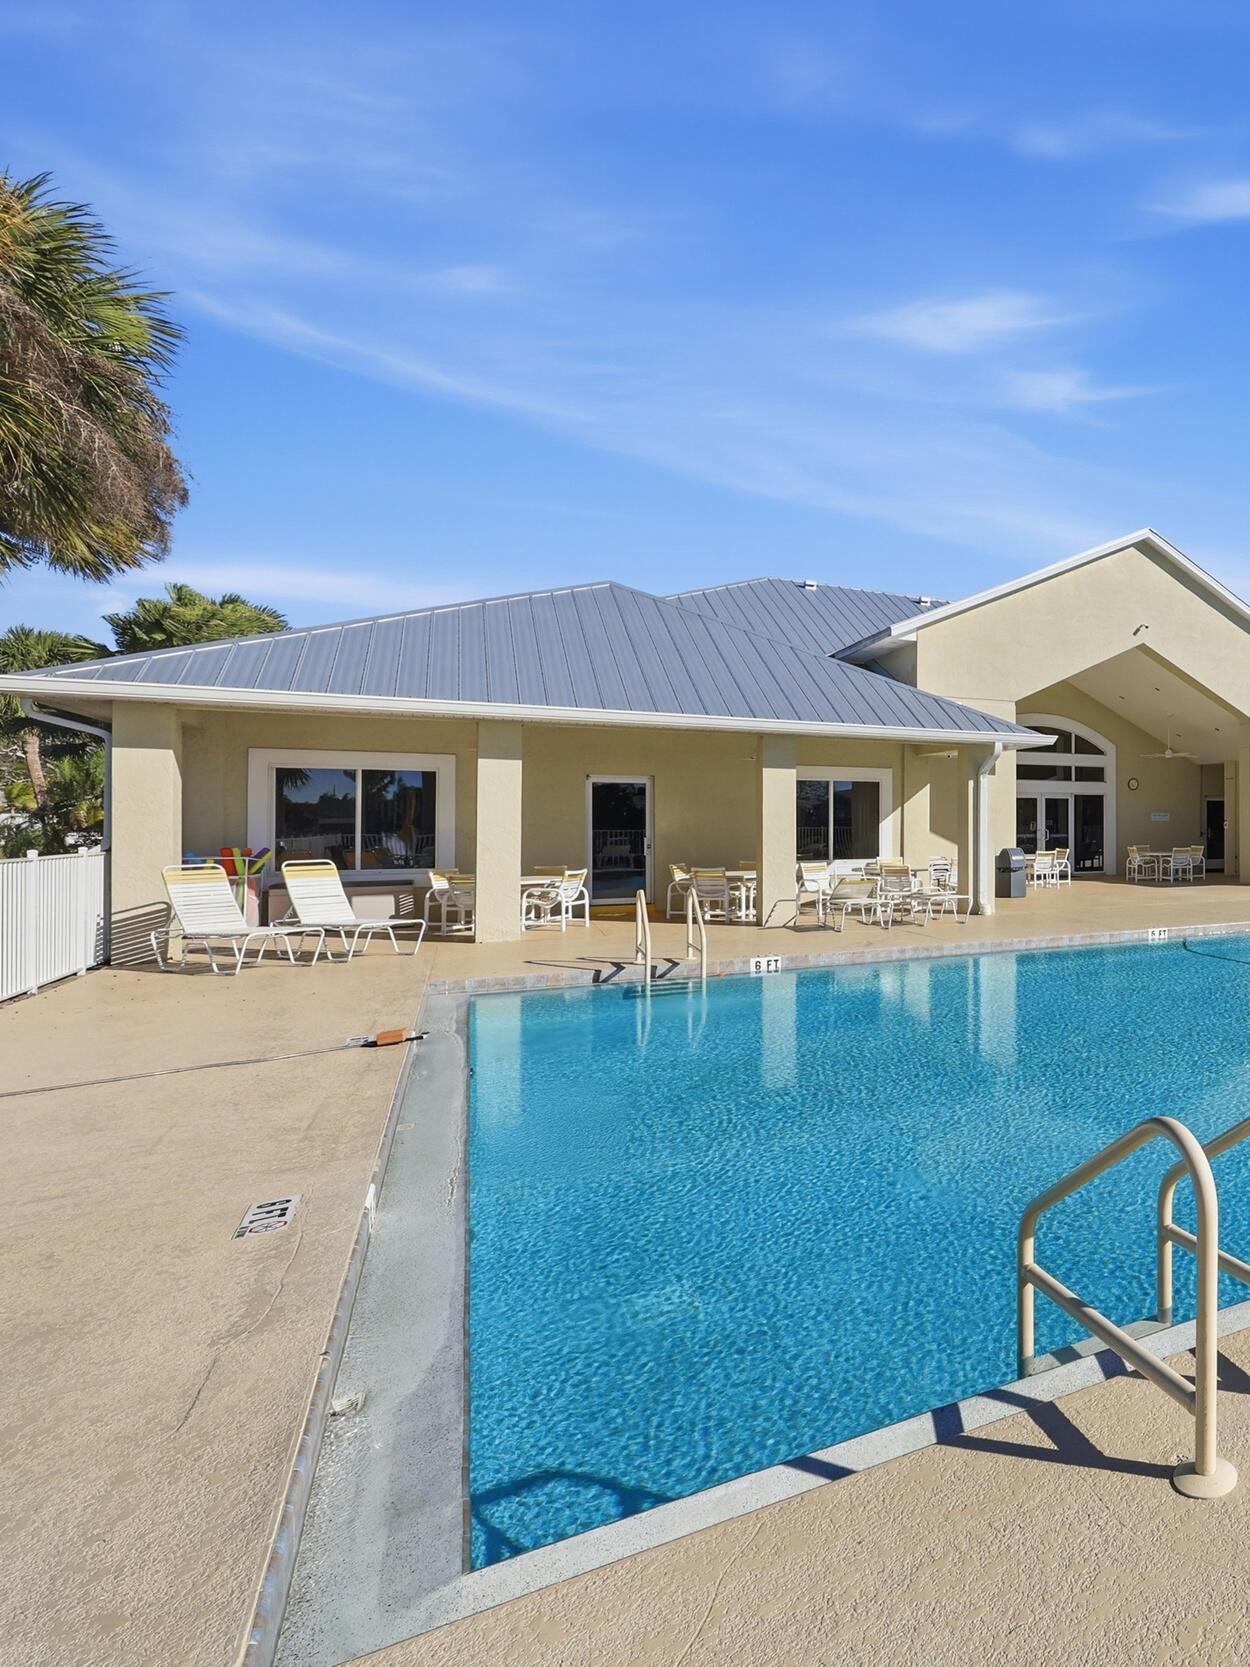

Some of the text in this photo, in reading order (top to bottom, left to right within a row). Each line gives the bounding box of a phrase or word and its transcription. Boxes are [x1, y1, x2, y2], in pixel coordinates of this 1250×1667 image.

[755, 959, 779, 970] 6 FT
[256, 1199, 292, 1209] 6
